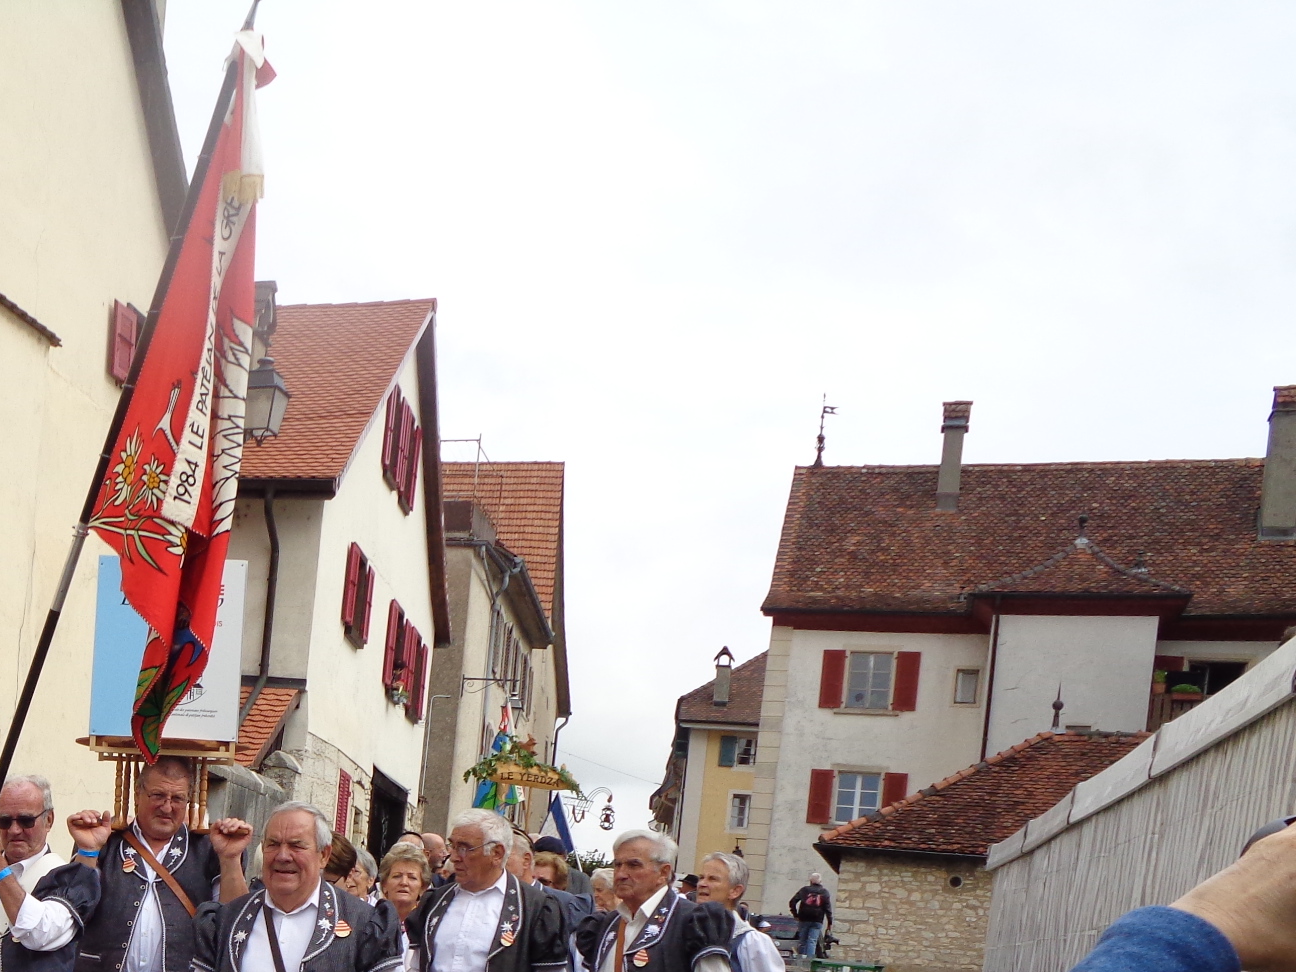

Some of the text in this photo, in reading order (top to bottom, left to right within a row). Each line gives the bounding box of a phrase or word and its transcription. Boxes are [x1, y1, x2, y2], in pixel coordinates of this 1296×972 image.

[173, 457, 200, 505] 1984
[216, 250, 226, 277] LA
[500, 772, 560, 787] LE YERDZA
